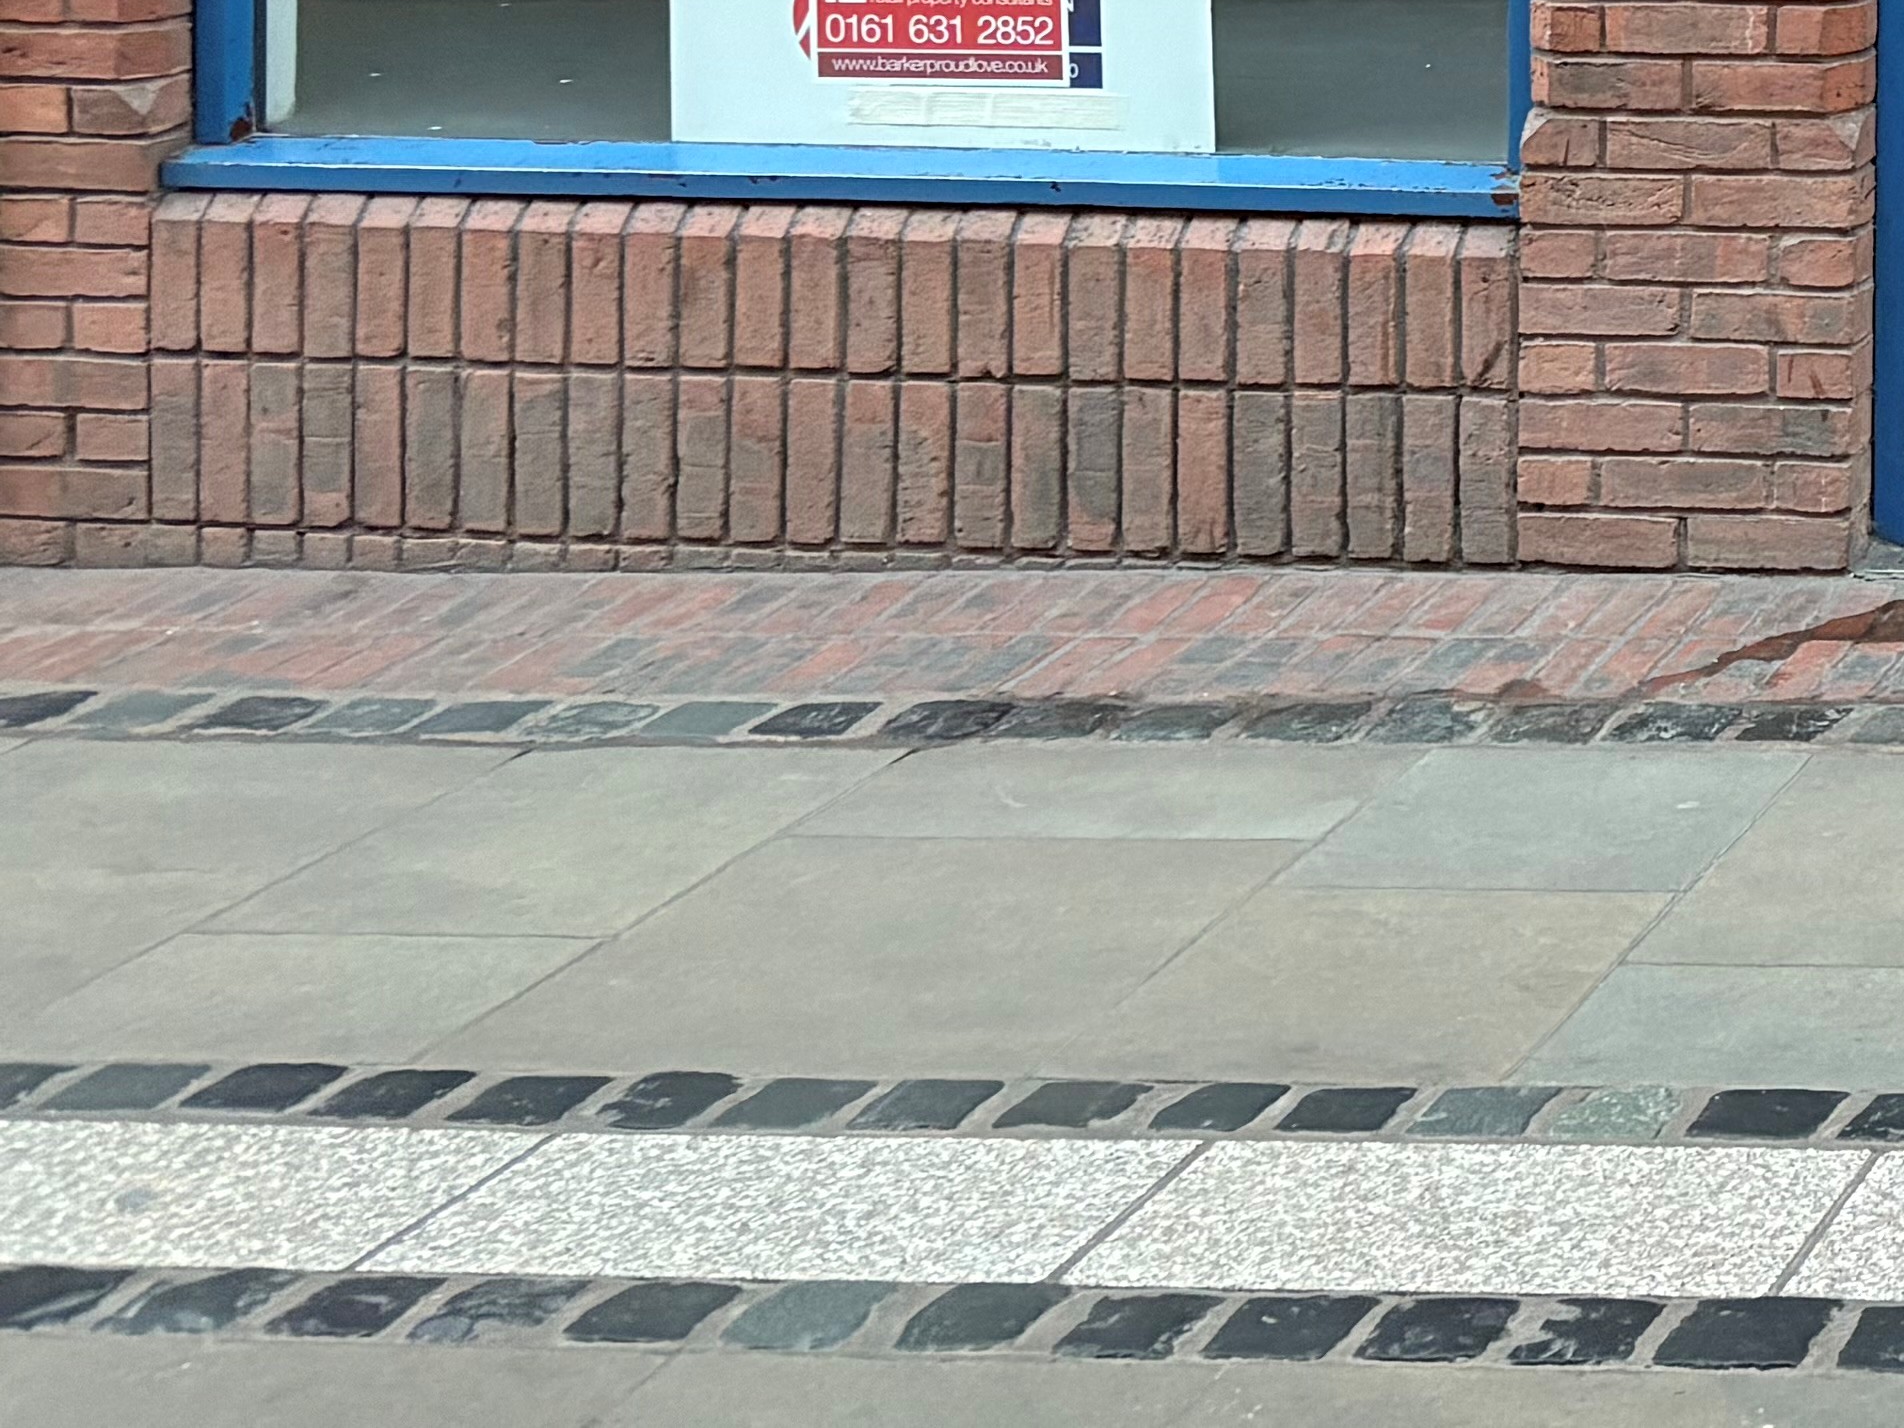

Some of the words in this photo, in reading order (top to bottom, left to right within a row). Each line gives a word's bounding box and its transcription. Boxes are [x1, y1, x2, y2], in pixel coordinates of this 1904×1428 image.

[825, 13, 894, 44] 0161
[908, 14, 963, 44] 631
[977, 16, 1055, 45] 2852
[831, 55, 1049, 75] www.barkerproudlove.co.uk
